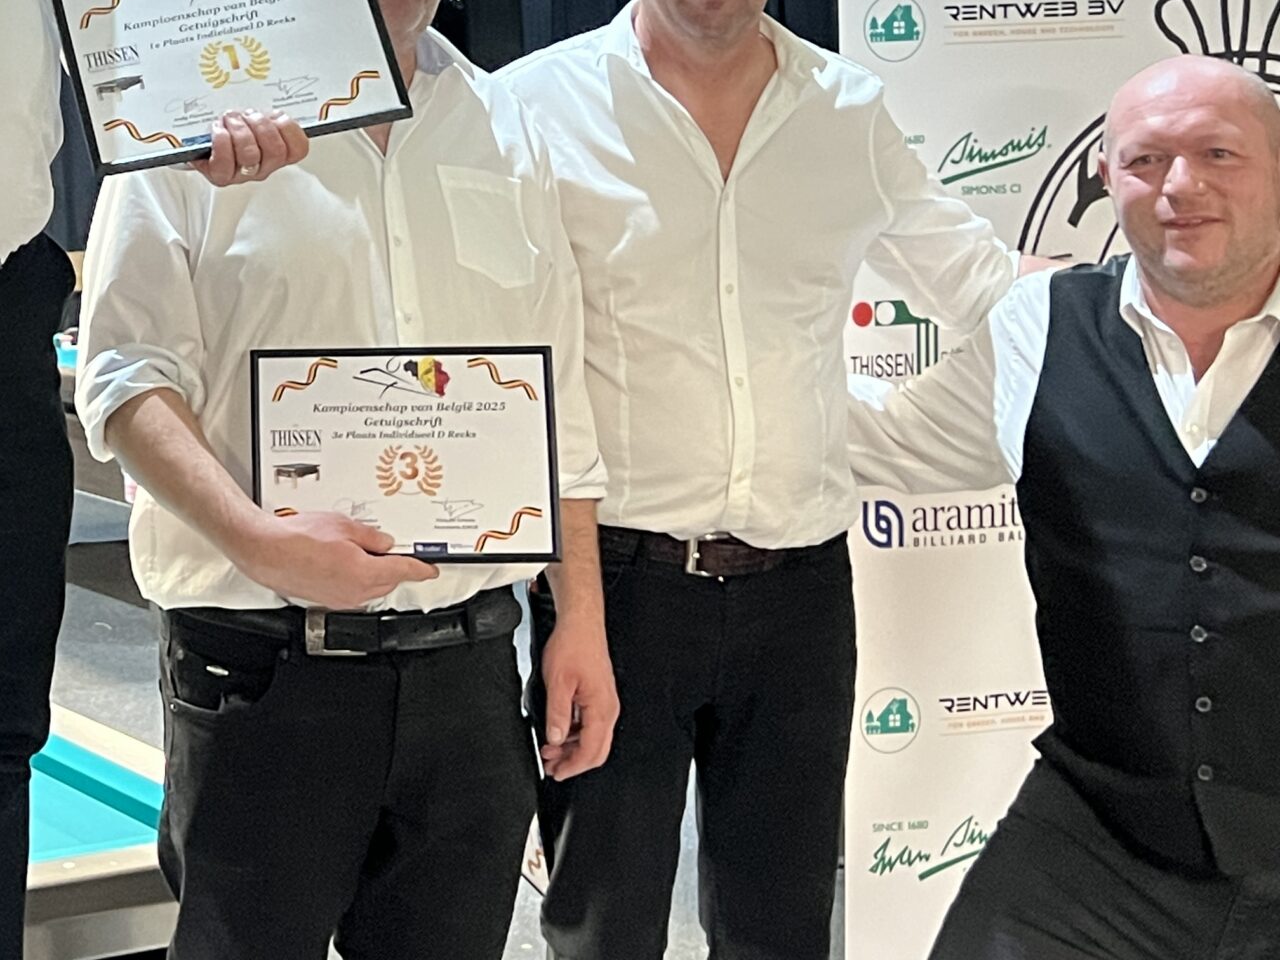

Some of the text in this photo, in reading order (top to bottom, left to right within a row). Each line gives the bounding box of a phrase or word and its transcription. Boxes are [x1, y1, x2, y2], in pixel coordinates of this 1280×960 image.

[123, 7, 221, 32] Kampioenschap
[223, 2, 247, 13] van
[944, 0, 1125, 21] RENTWEB BV
[178, 10, 259, 34] Getuigschrift
[162, 36, 195, 48] Plaats
[83, 44, 140, 71] THISSEN
[221, 44, 241, 70] 1
[961, 184, 1007, 196] SIMONIS
[850, 353, 914, 378] THISSEN
[313, 401, 506, 415] Kampioenschap van België 2025
[363, 416, 443, 428] Getuigschrift
[270, 429, 322, 449] THISSEN
[331, 430, 477, 439] 3e Plaats Individueel D Reeks
[398, 451, 420, 481] 3
[911, 494, 1020, 533] aramit
[913, 531, 1023, 548] BILLIARD BAL
[939, 690, 1048, 713] RENTWE
[872, 821, 904, 833] SINCE
